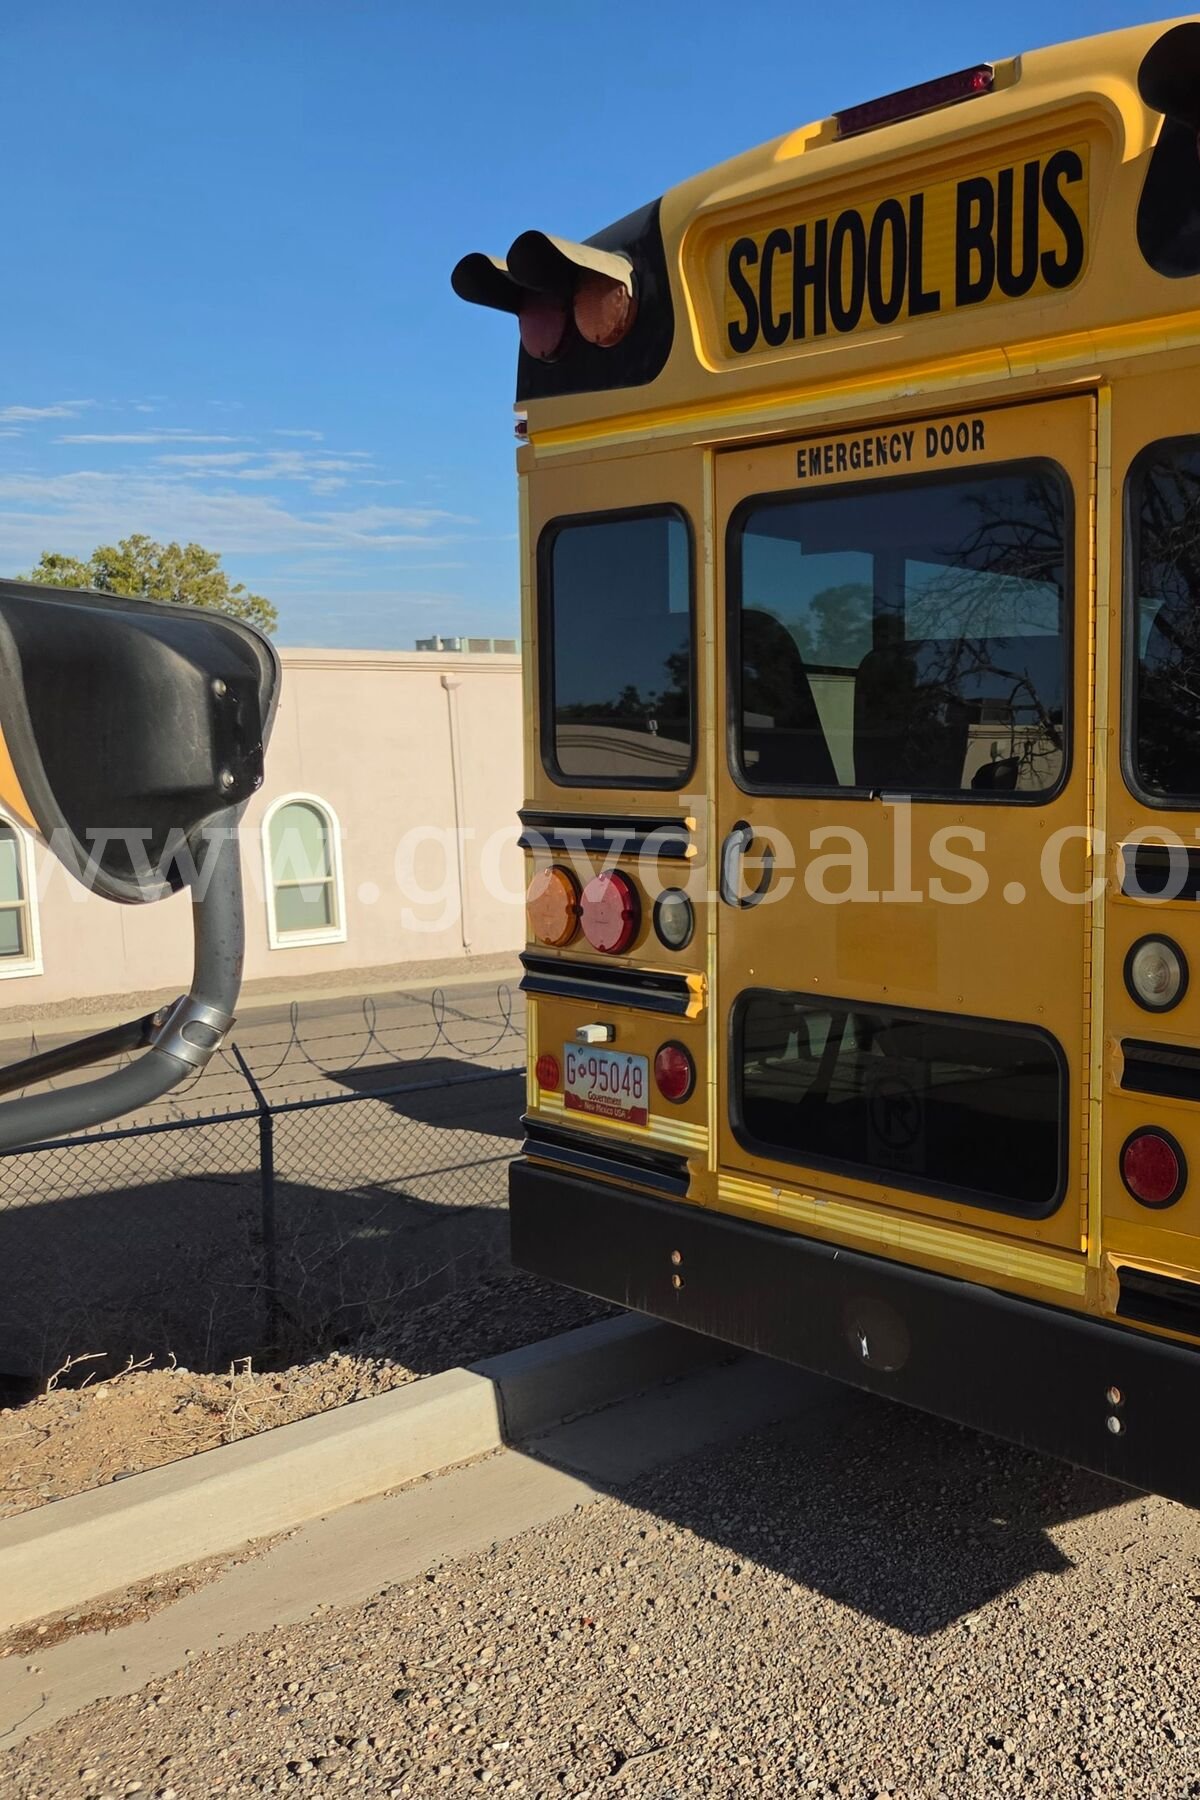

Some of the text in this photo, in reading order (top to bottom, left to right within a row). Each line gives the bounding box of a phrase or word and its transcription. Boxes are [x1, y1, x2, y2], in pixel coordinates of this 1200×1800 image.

[727, 149, 1085, 354] SCHOOL BUS
[797, 419, 985, 479] EMERGENCY DOOR
